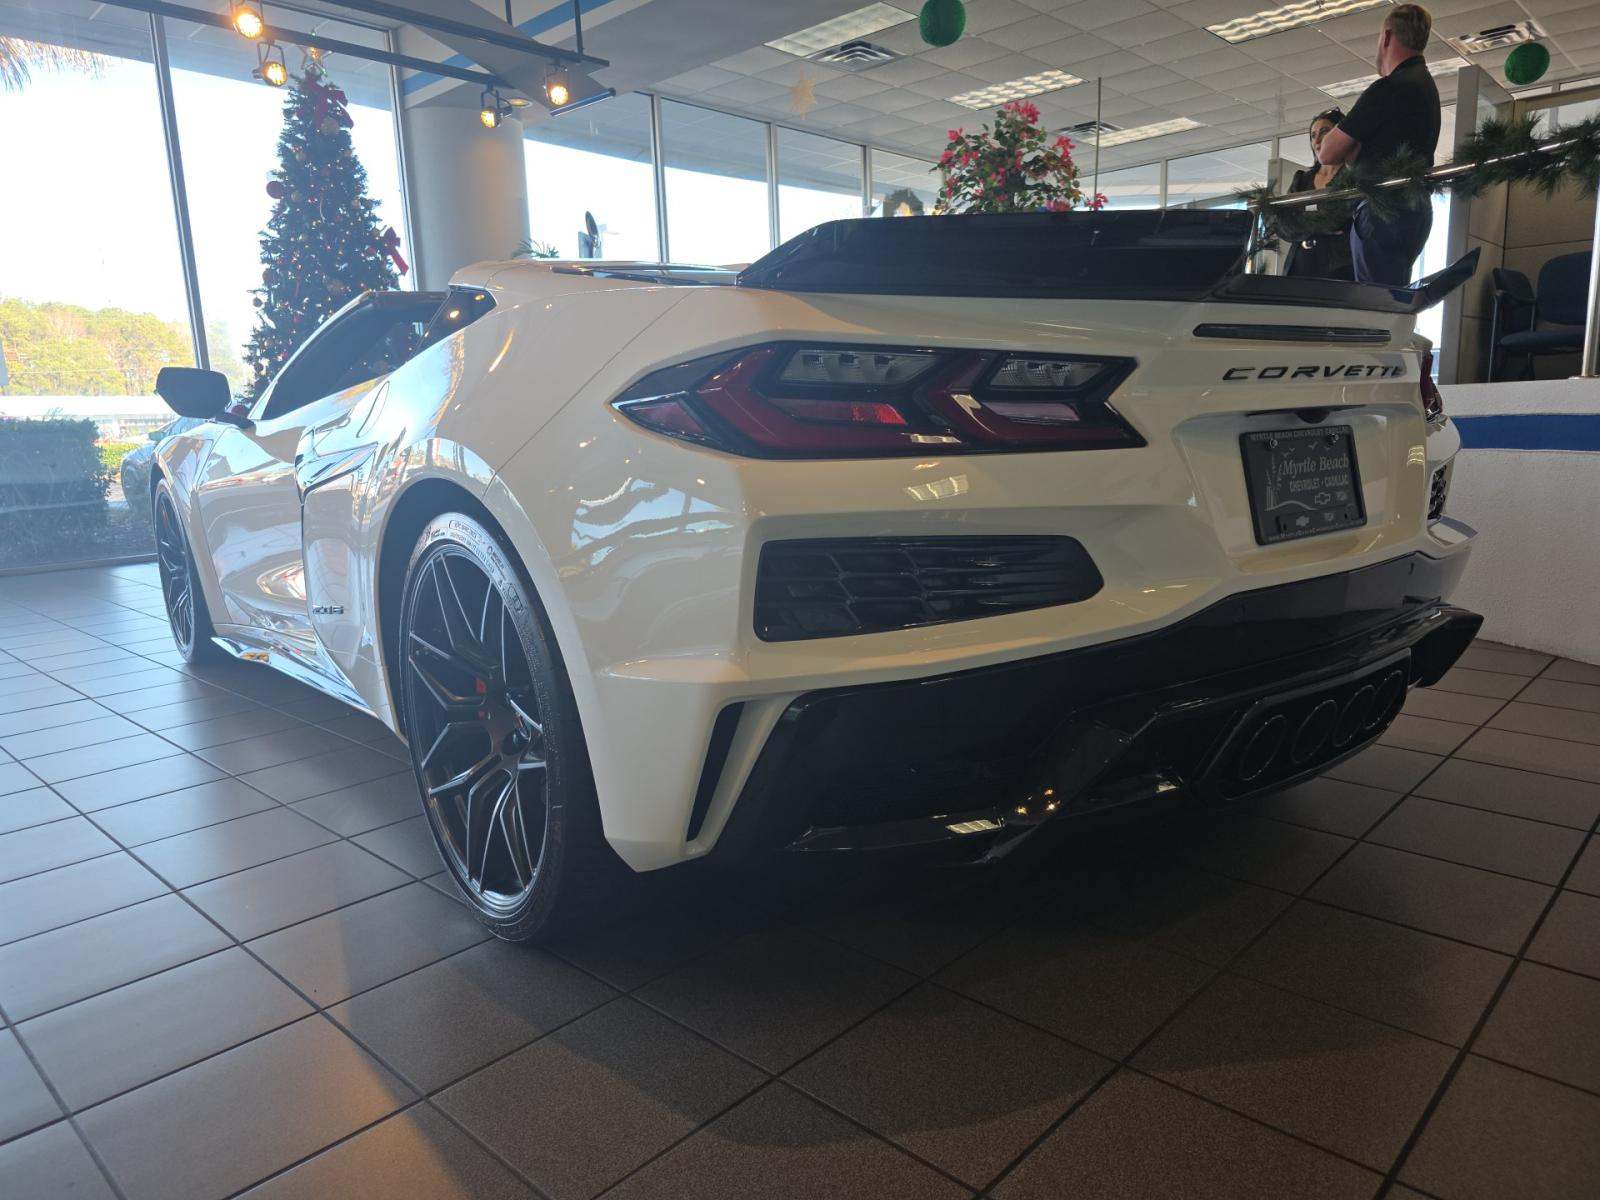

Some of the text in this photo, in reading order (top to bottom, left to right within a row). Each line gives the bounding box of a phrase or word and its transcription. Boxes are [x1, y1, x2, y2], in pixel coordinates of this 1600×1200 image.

[1222, 364, 1404, 381] CORVETTE
[1282, 454, 1349, 479] Myrtle Beach
